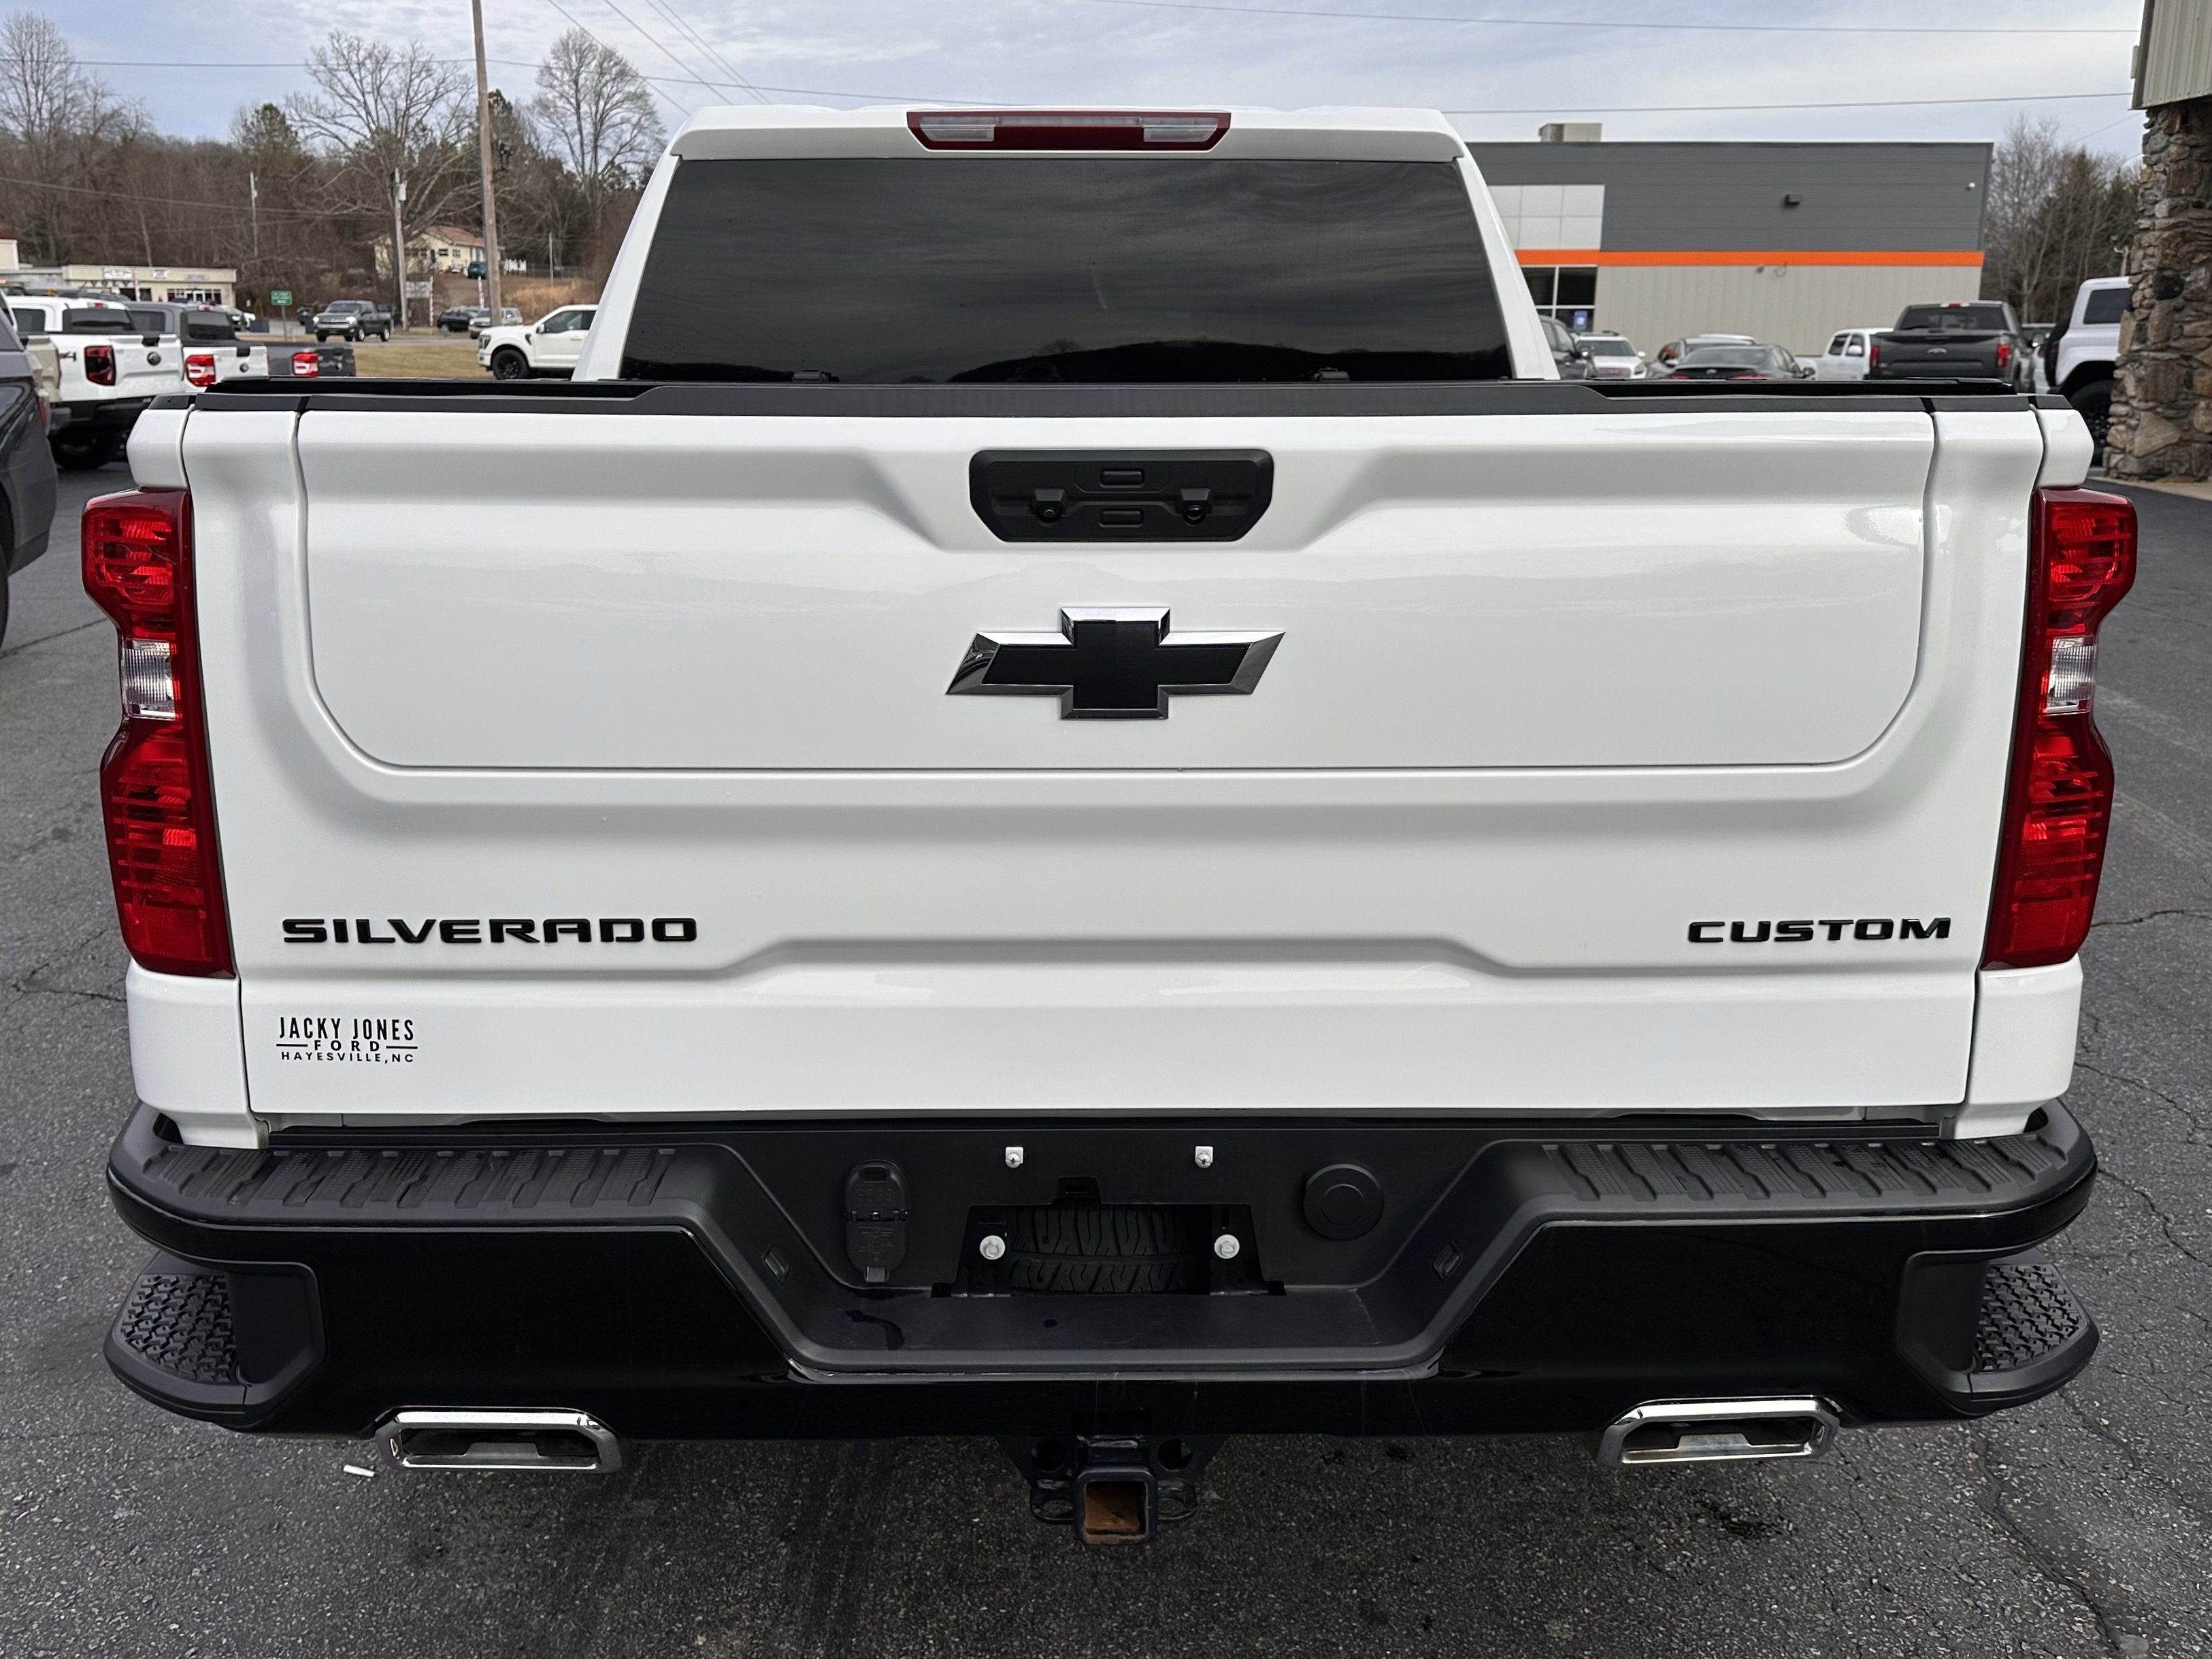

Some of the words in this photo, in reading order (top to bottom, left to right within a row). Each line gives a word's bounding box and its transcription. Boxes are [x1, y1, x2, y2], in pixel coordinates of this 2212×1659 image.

[282, 918, 698, 945] SILVERADO
[1687, 917, 1952, 943] CUSTOM
[279, 1017, 341, 1039] JACKY
[352, 1018, 414, 1040] JONES
[314, 1040, 380, 1052] FORD
